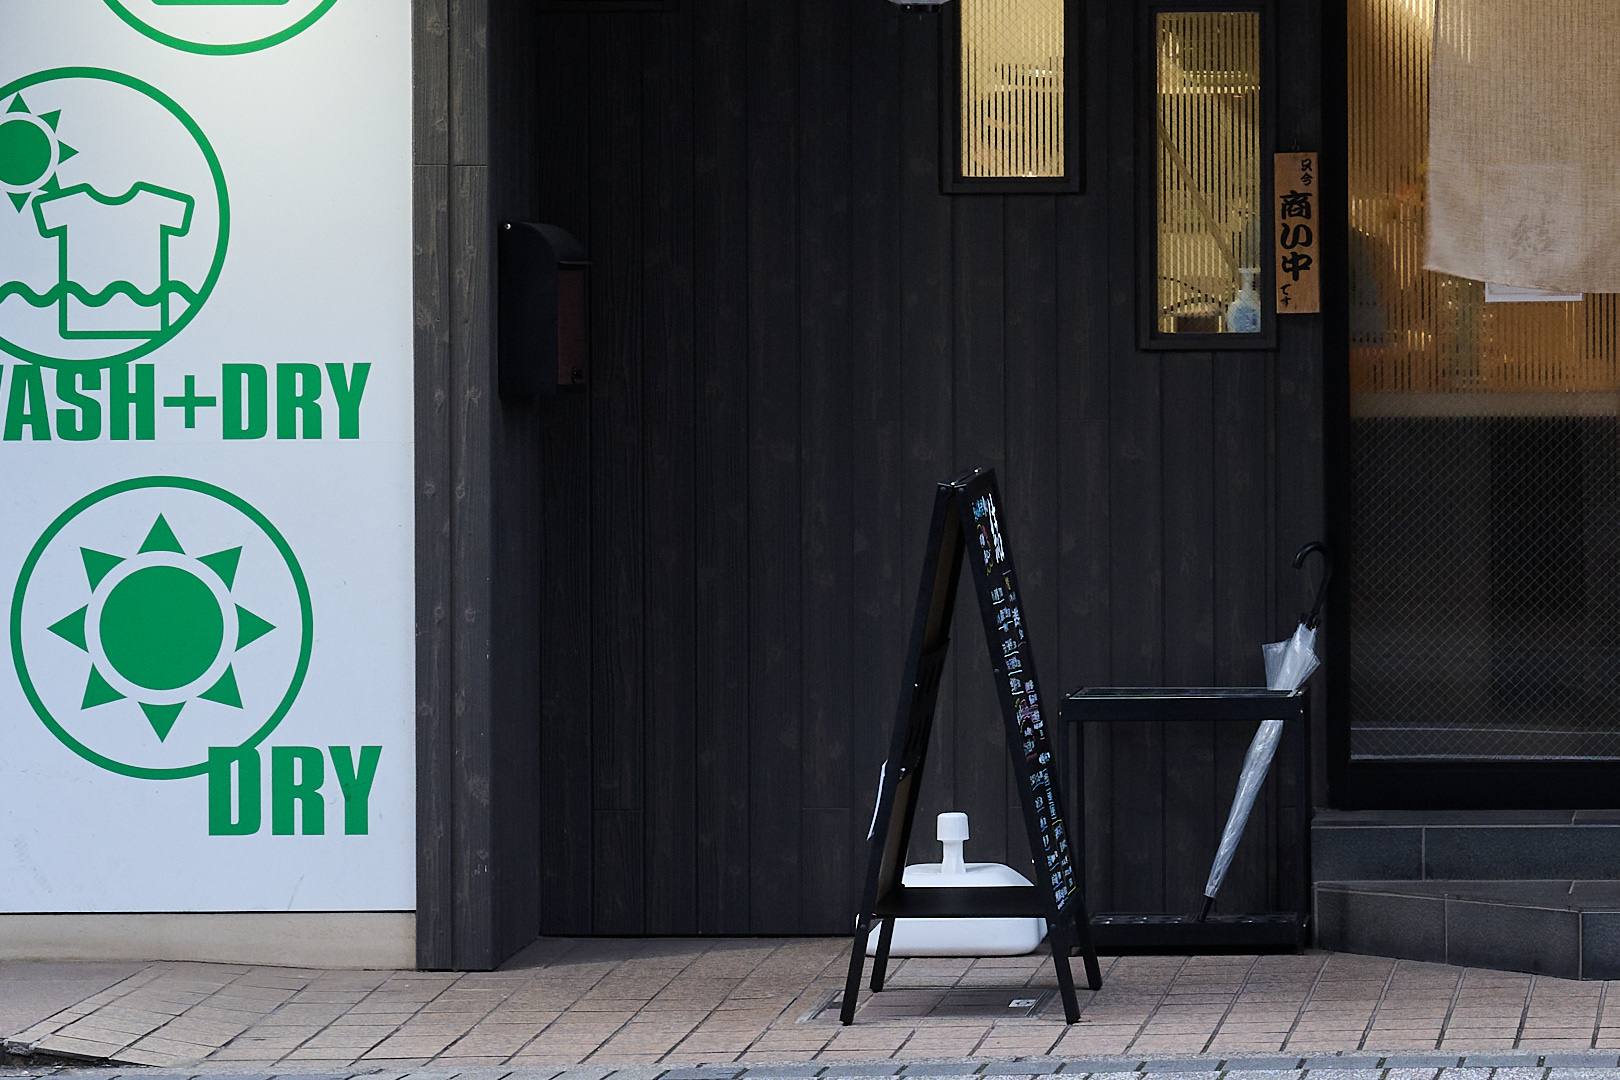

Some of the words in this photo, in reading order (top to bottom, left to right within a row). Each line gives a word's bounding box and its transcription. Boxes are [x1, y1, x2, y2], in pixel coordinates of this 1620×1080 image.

[1300, 158, 1314, 187] 只今
[1279, 189, 1314, 283] 商い中
[0, 362, 372, 442] ASH+DRY
[208, 745, 383, 836] DRY
